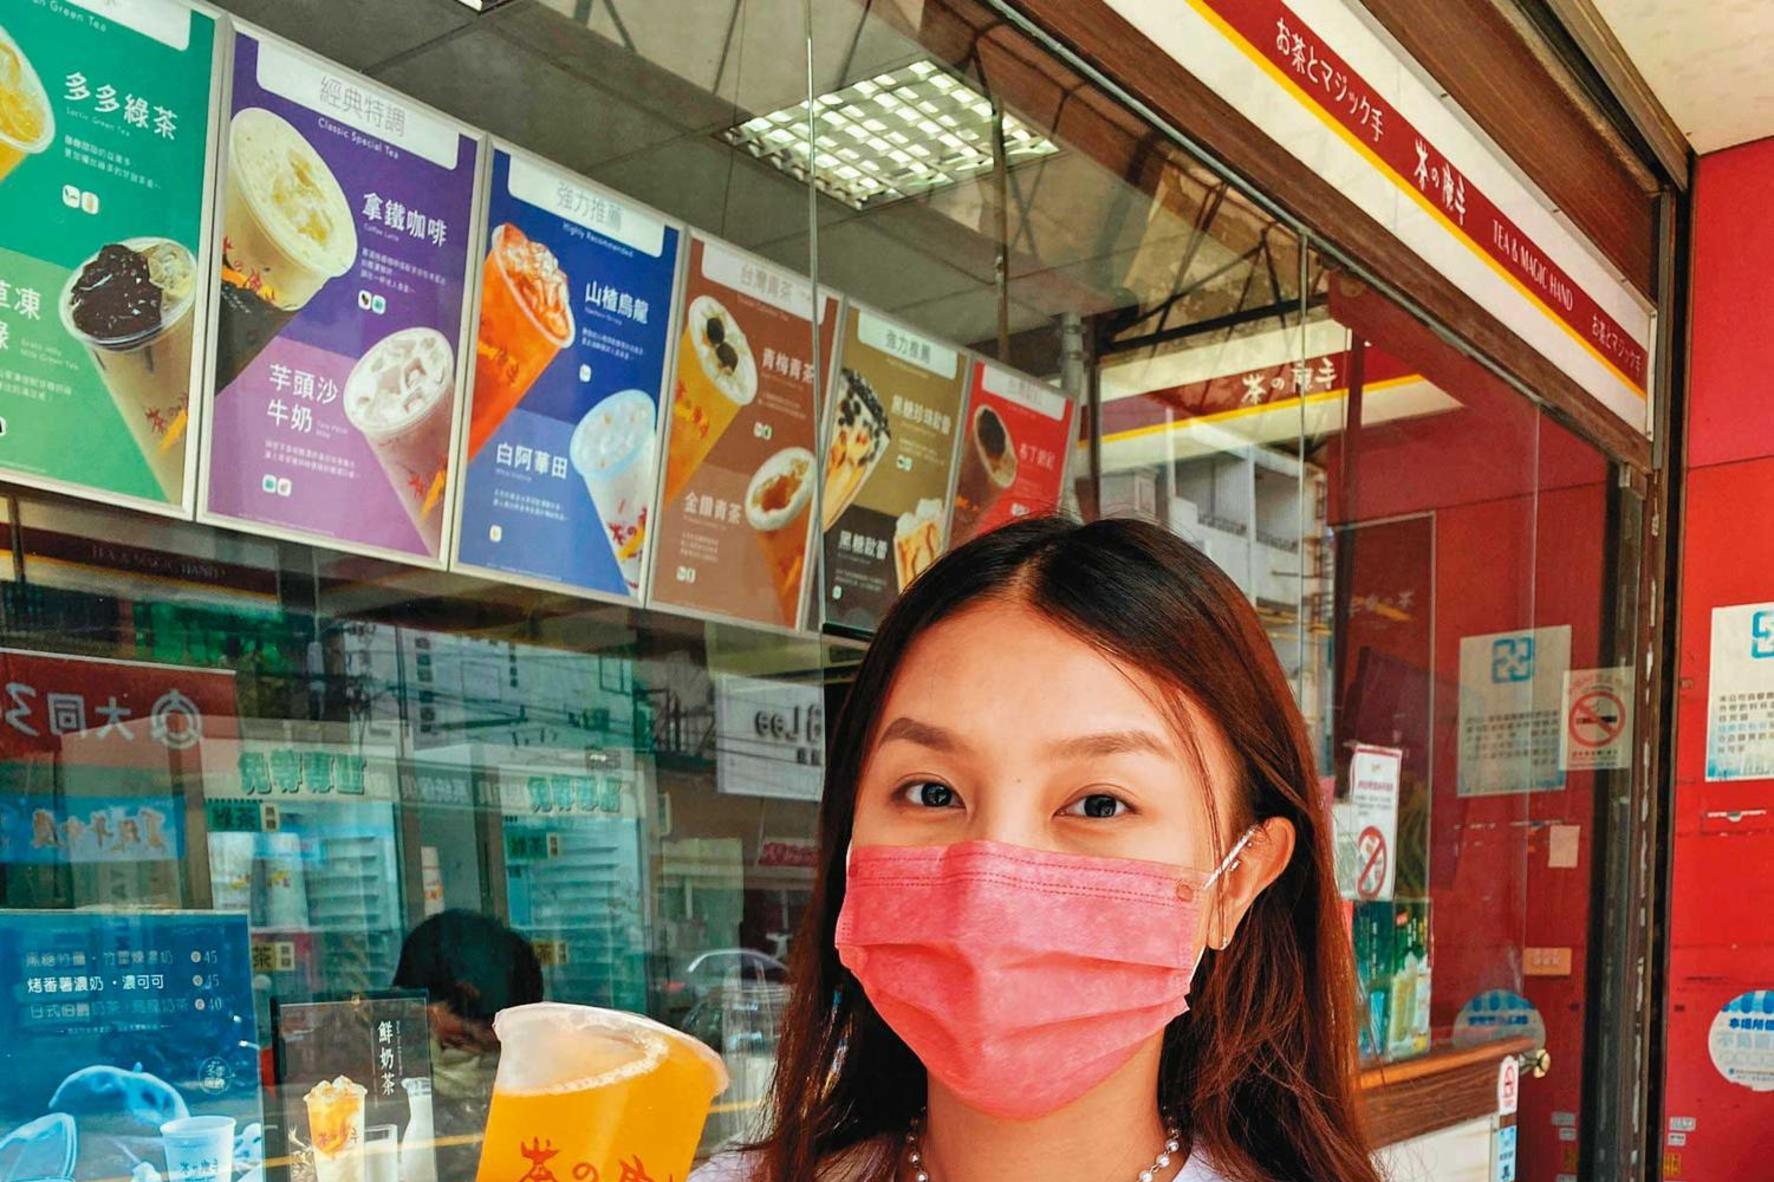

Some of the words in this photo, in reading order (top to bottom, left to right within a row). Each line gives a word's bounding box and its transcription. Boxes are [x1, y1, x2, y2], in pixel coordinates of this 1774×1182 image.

[49, 0, 84, 22] Green
[88, 15, 107, 33] Tea
[64, 71, 179, 140] 多多綠茶
[1276, 17, 1384, 142] お茶とマジック手
[319, 74, 406, 138] 經典特調
[318, 116, 350, 139] Classic
[351, 130, 384, 154] Special
[385, 143, 399, 160] Tea
[361, 191, 448, 248] 拿鐵咖啡
[555, 181, 625, 233] 強力推薦
[1492, 219, 1510, 256] TEA
[1520, 246, 1548, 289] MAGIC
[1550, 276, 1574, 312] HAND
[584, 280, 650, 325] 山楂烏龍
[268, 362, 339, 405] 芋頭沙
[266, 398, 313, 434] 牛奶
[496, 442, 568, 480] 白阿華田
[377, 1020, 396, 1096] 鮮奶茶
